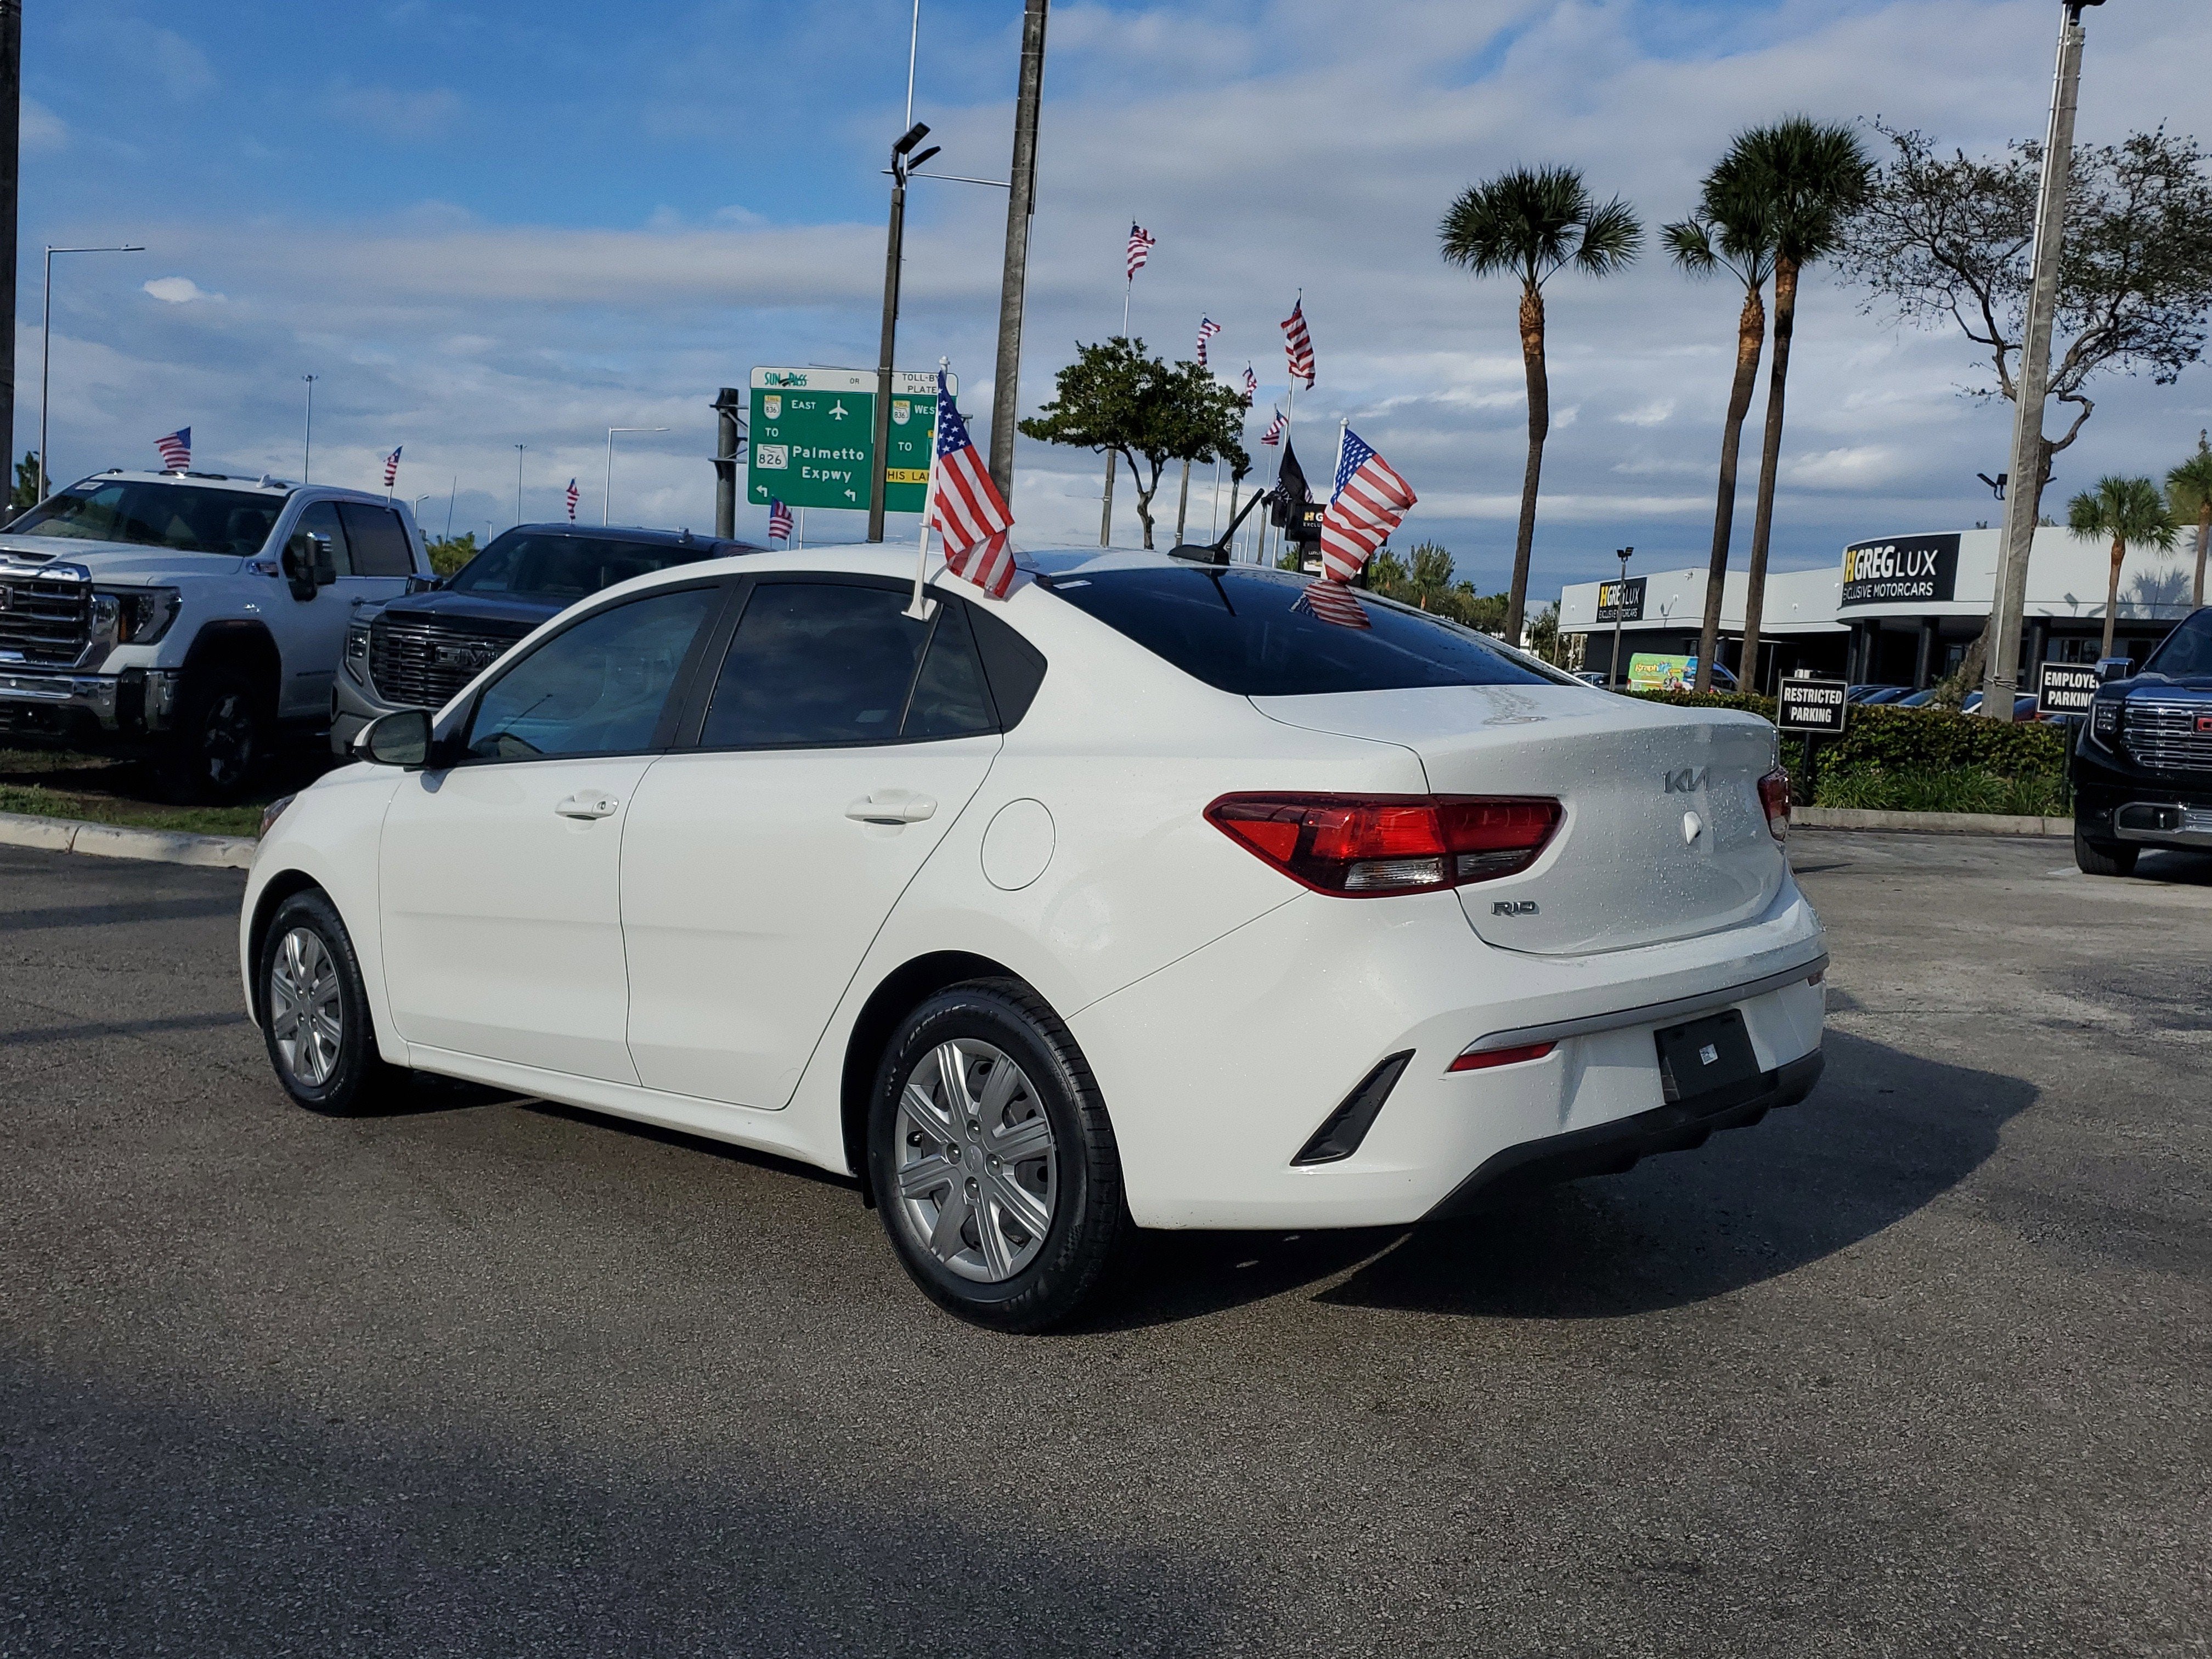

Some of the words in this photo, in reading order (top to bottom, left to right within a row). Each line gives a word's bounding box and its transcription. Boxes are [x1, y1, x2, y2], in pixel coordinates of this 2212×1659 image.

[907, 385, 937, 394] PLATE
[791, 400, 816, 410] EAST
[915, 404, 936, 415] WES
[765, 427, 779, 437] TO
[898, 442, 912, 452] TO
[793, 445, 864, 461] Palmetto
[759, 454, 782, 465] 826
[802, 466, 851, 483] Expwy
[888, 471, 905, 480] HIS
[912, 472, 930, 481] LA
[1304, 511, 1323, 522] HG
[1843, 584, 1872, 601] EXCLUSIVE
[1873, 582, 1933, 598] MOTORCARS
[1784, 687, 1843, 704] RESTRICTED
[1791, 706, 1832, 723] PARKING
[1491, 901, 1539, 917] RIO
